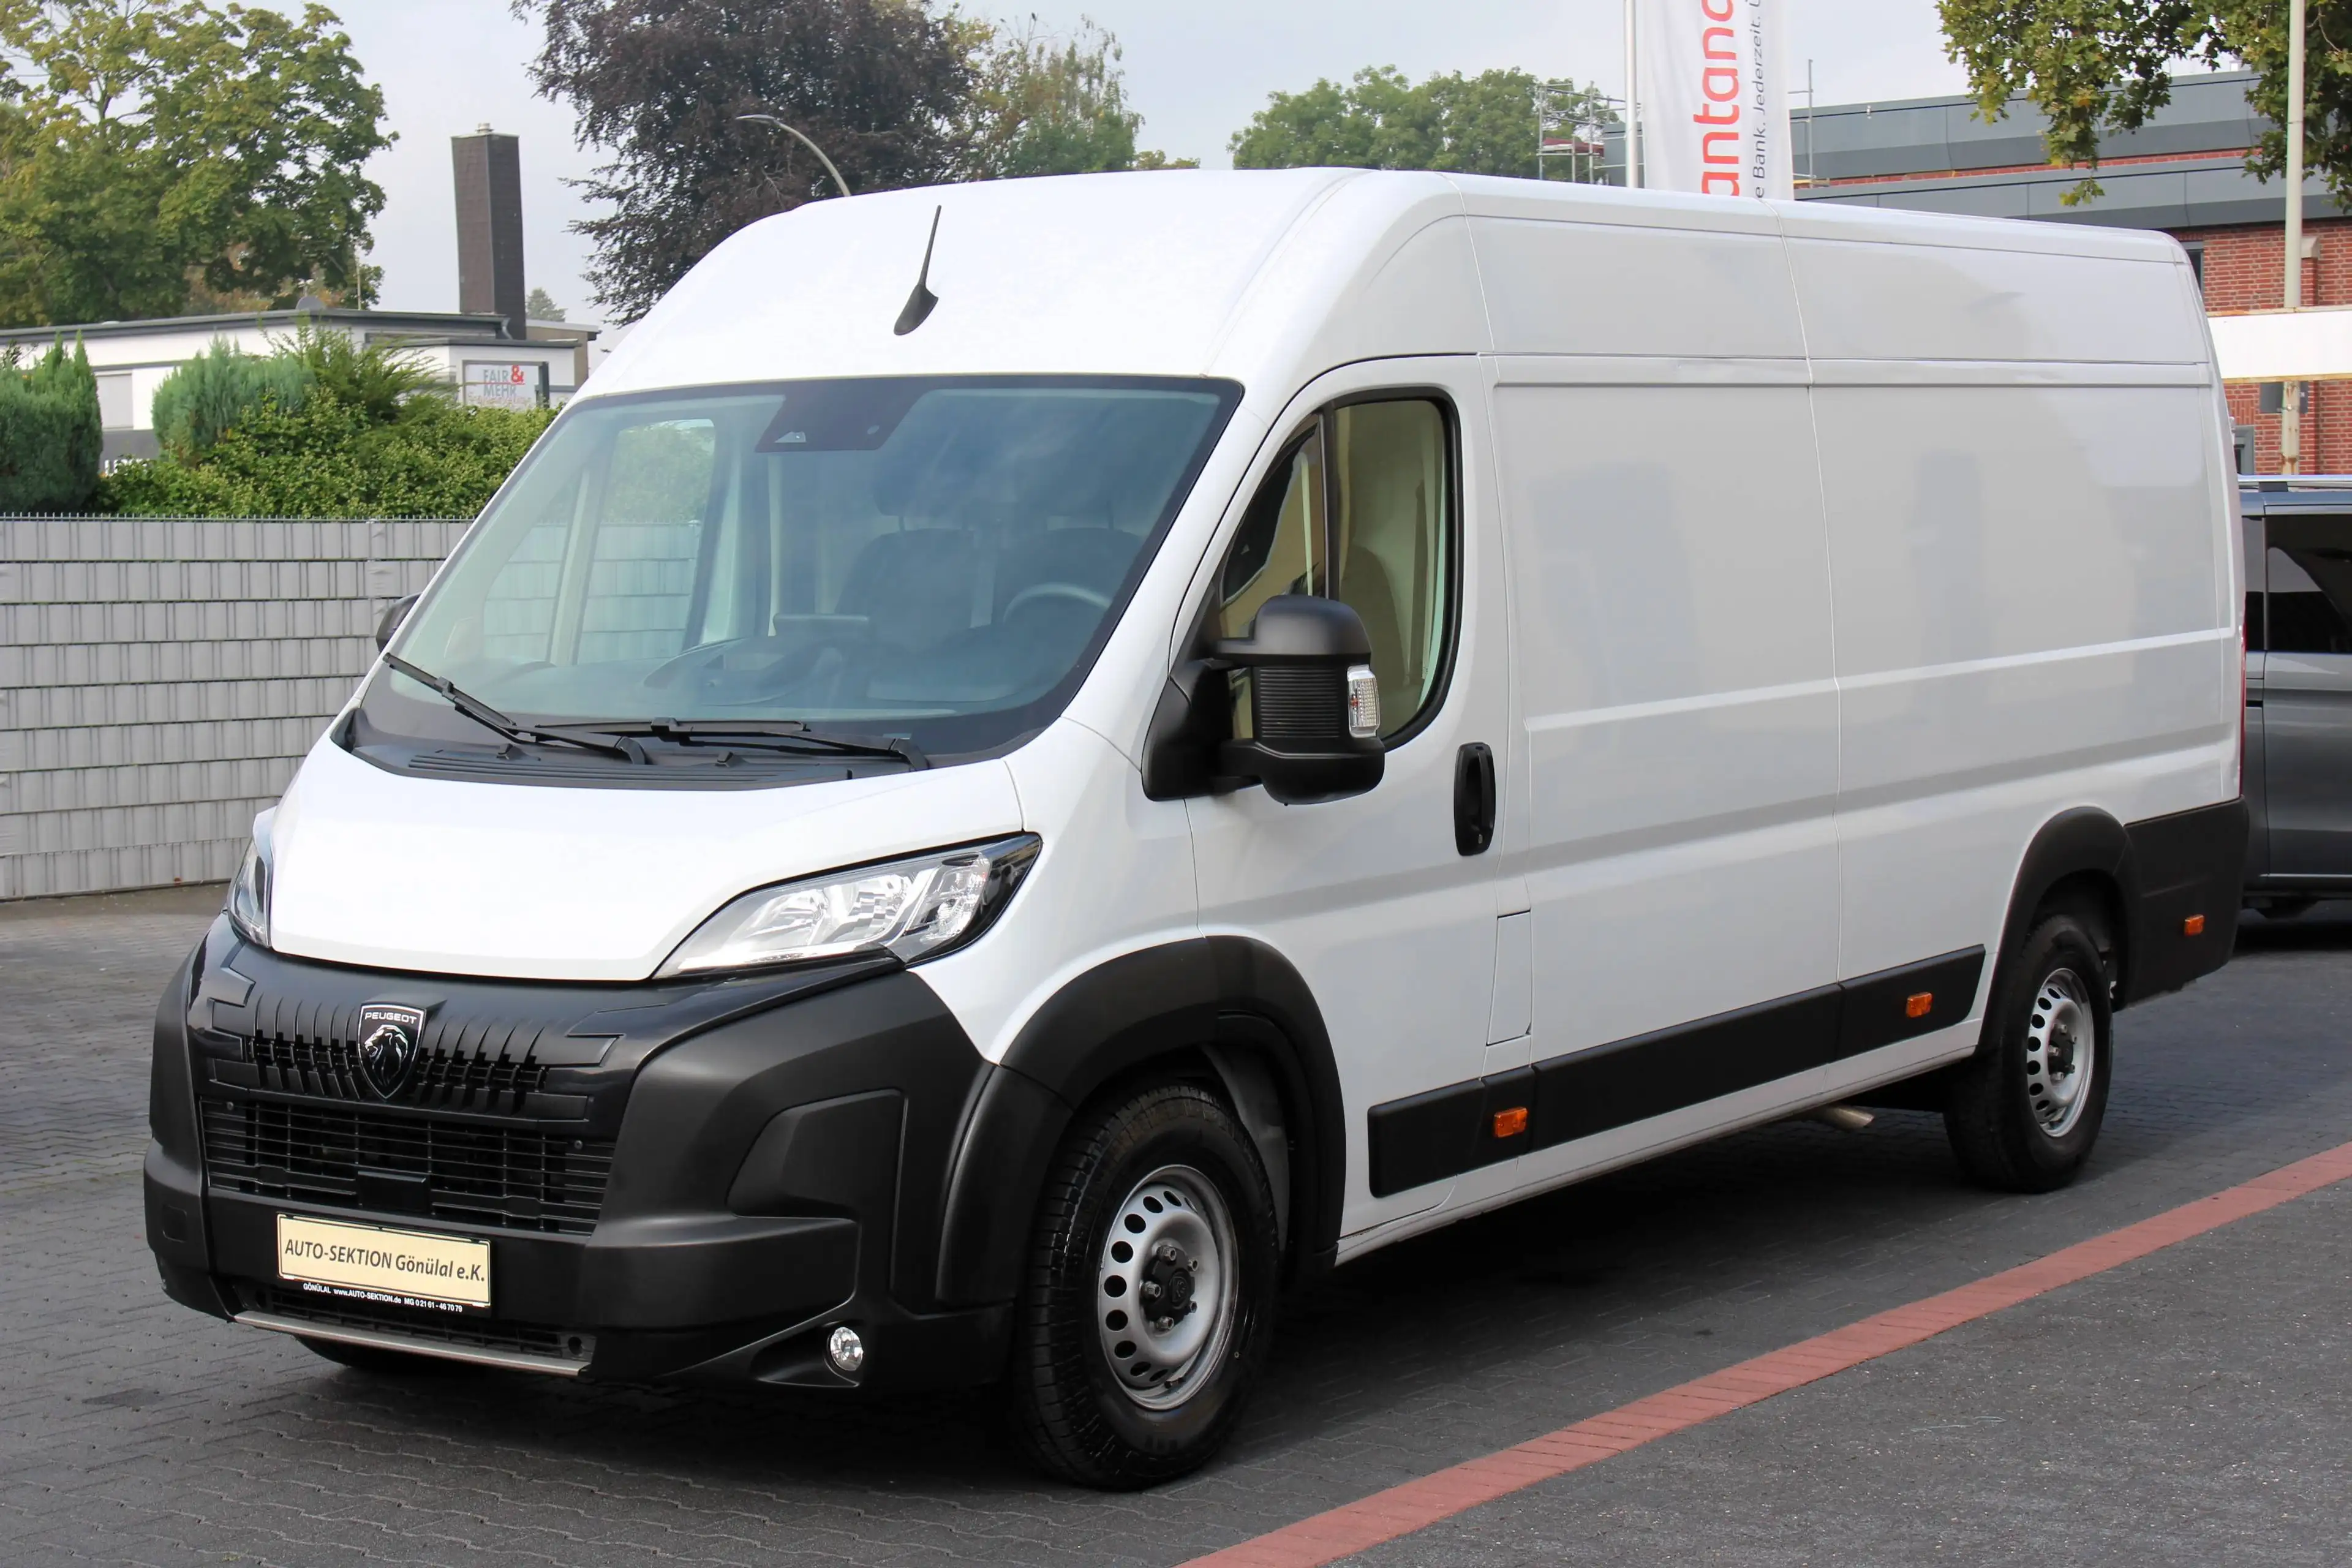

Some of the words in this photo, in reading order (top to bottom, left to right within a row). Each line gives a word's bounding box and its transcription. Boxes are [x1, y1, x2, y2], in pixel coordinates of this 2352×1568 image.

[1749, 16, 1765, 115] Jederzeit.
[1752, 123, 1766, 178] Bank.
[483, 369, 509, 382] FAIR
[511, 365, 524, 383] &
[483, 385, 517, 398] MEHR
[364, 1012, 417, 1024] PEUGEOT
[285, 1238, 392, 1269] AUTO-SEKTION
[396, 1254, 453, 1278] Gönülal
[457, 1264, 484, 1282] e.K.
[303, 1283, 331, 1294] GÖNÜLAL
[333, 1289, 402, 1303] www.AUTO-SEKTION.de
